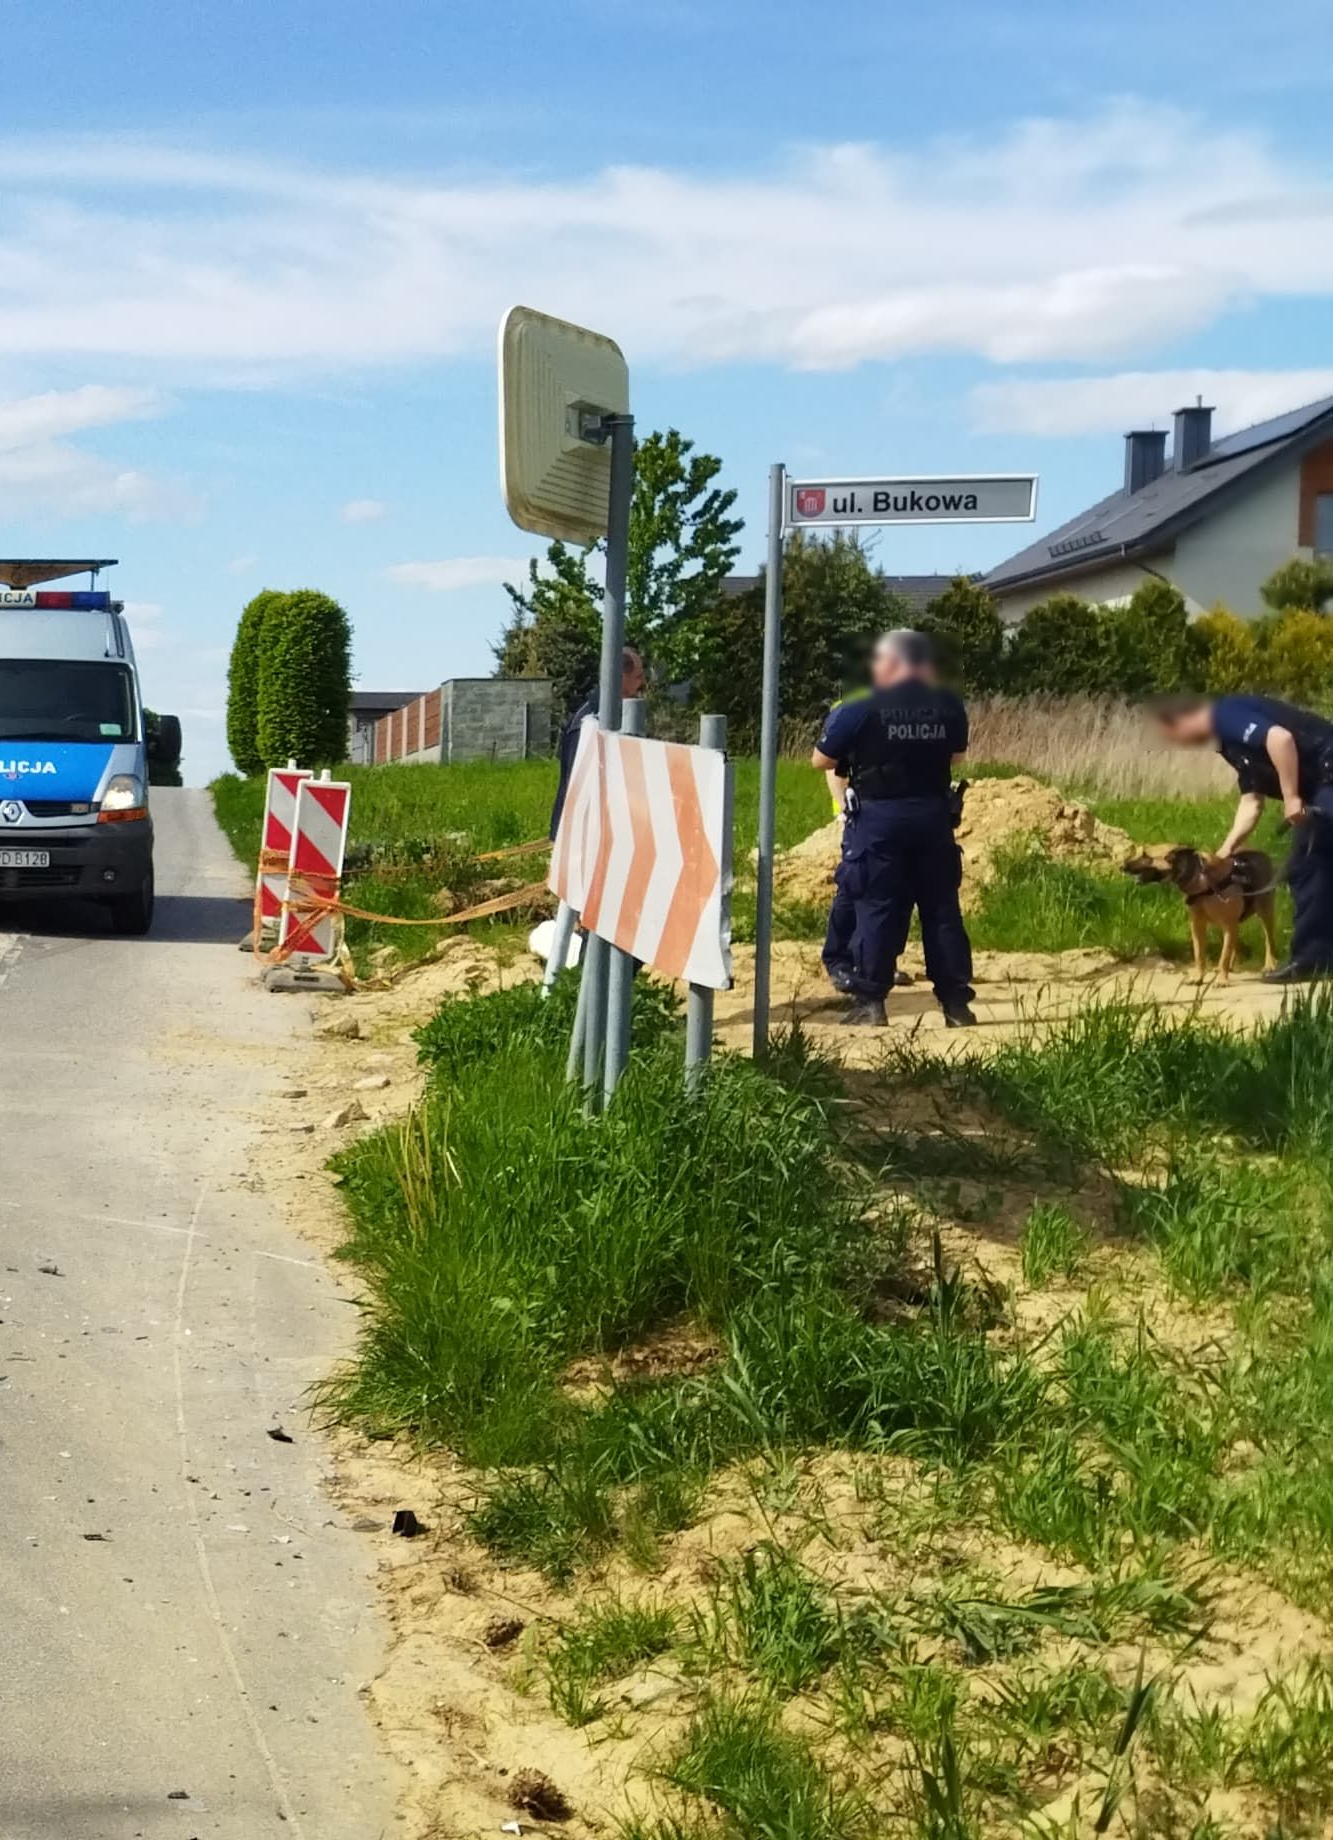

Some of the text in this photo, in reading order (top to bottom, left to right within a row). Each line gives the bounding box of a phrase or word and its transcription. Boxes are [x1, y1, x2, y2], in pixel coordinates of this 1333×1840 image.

[832, 490, 978, 513] ul. Bukowa
[887, 723, 947, 740] POLICJA
